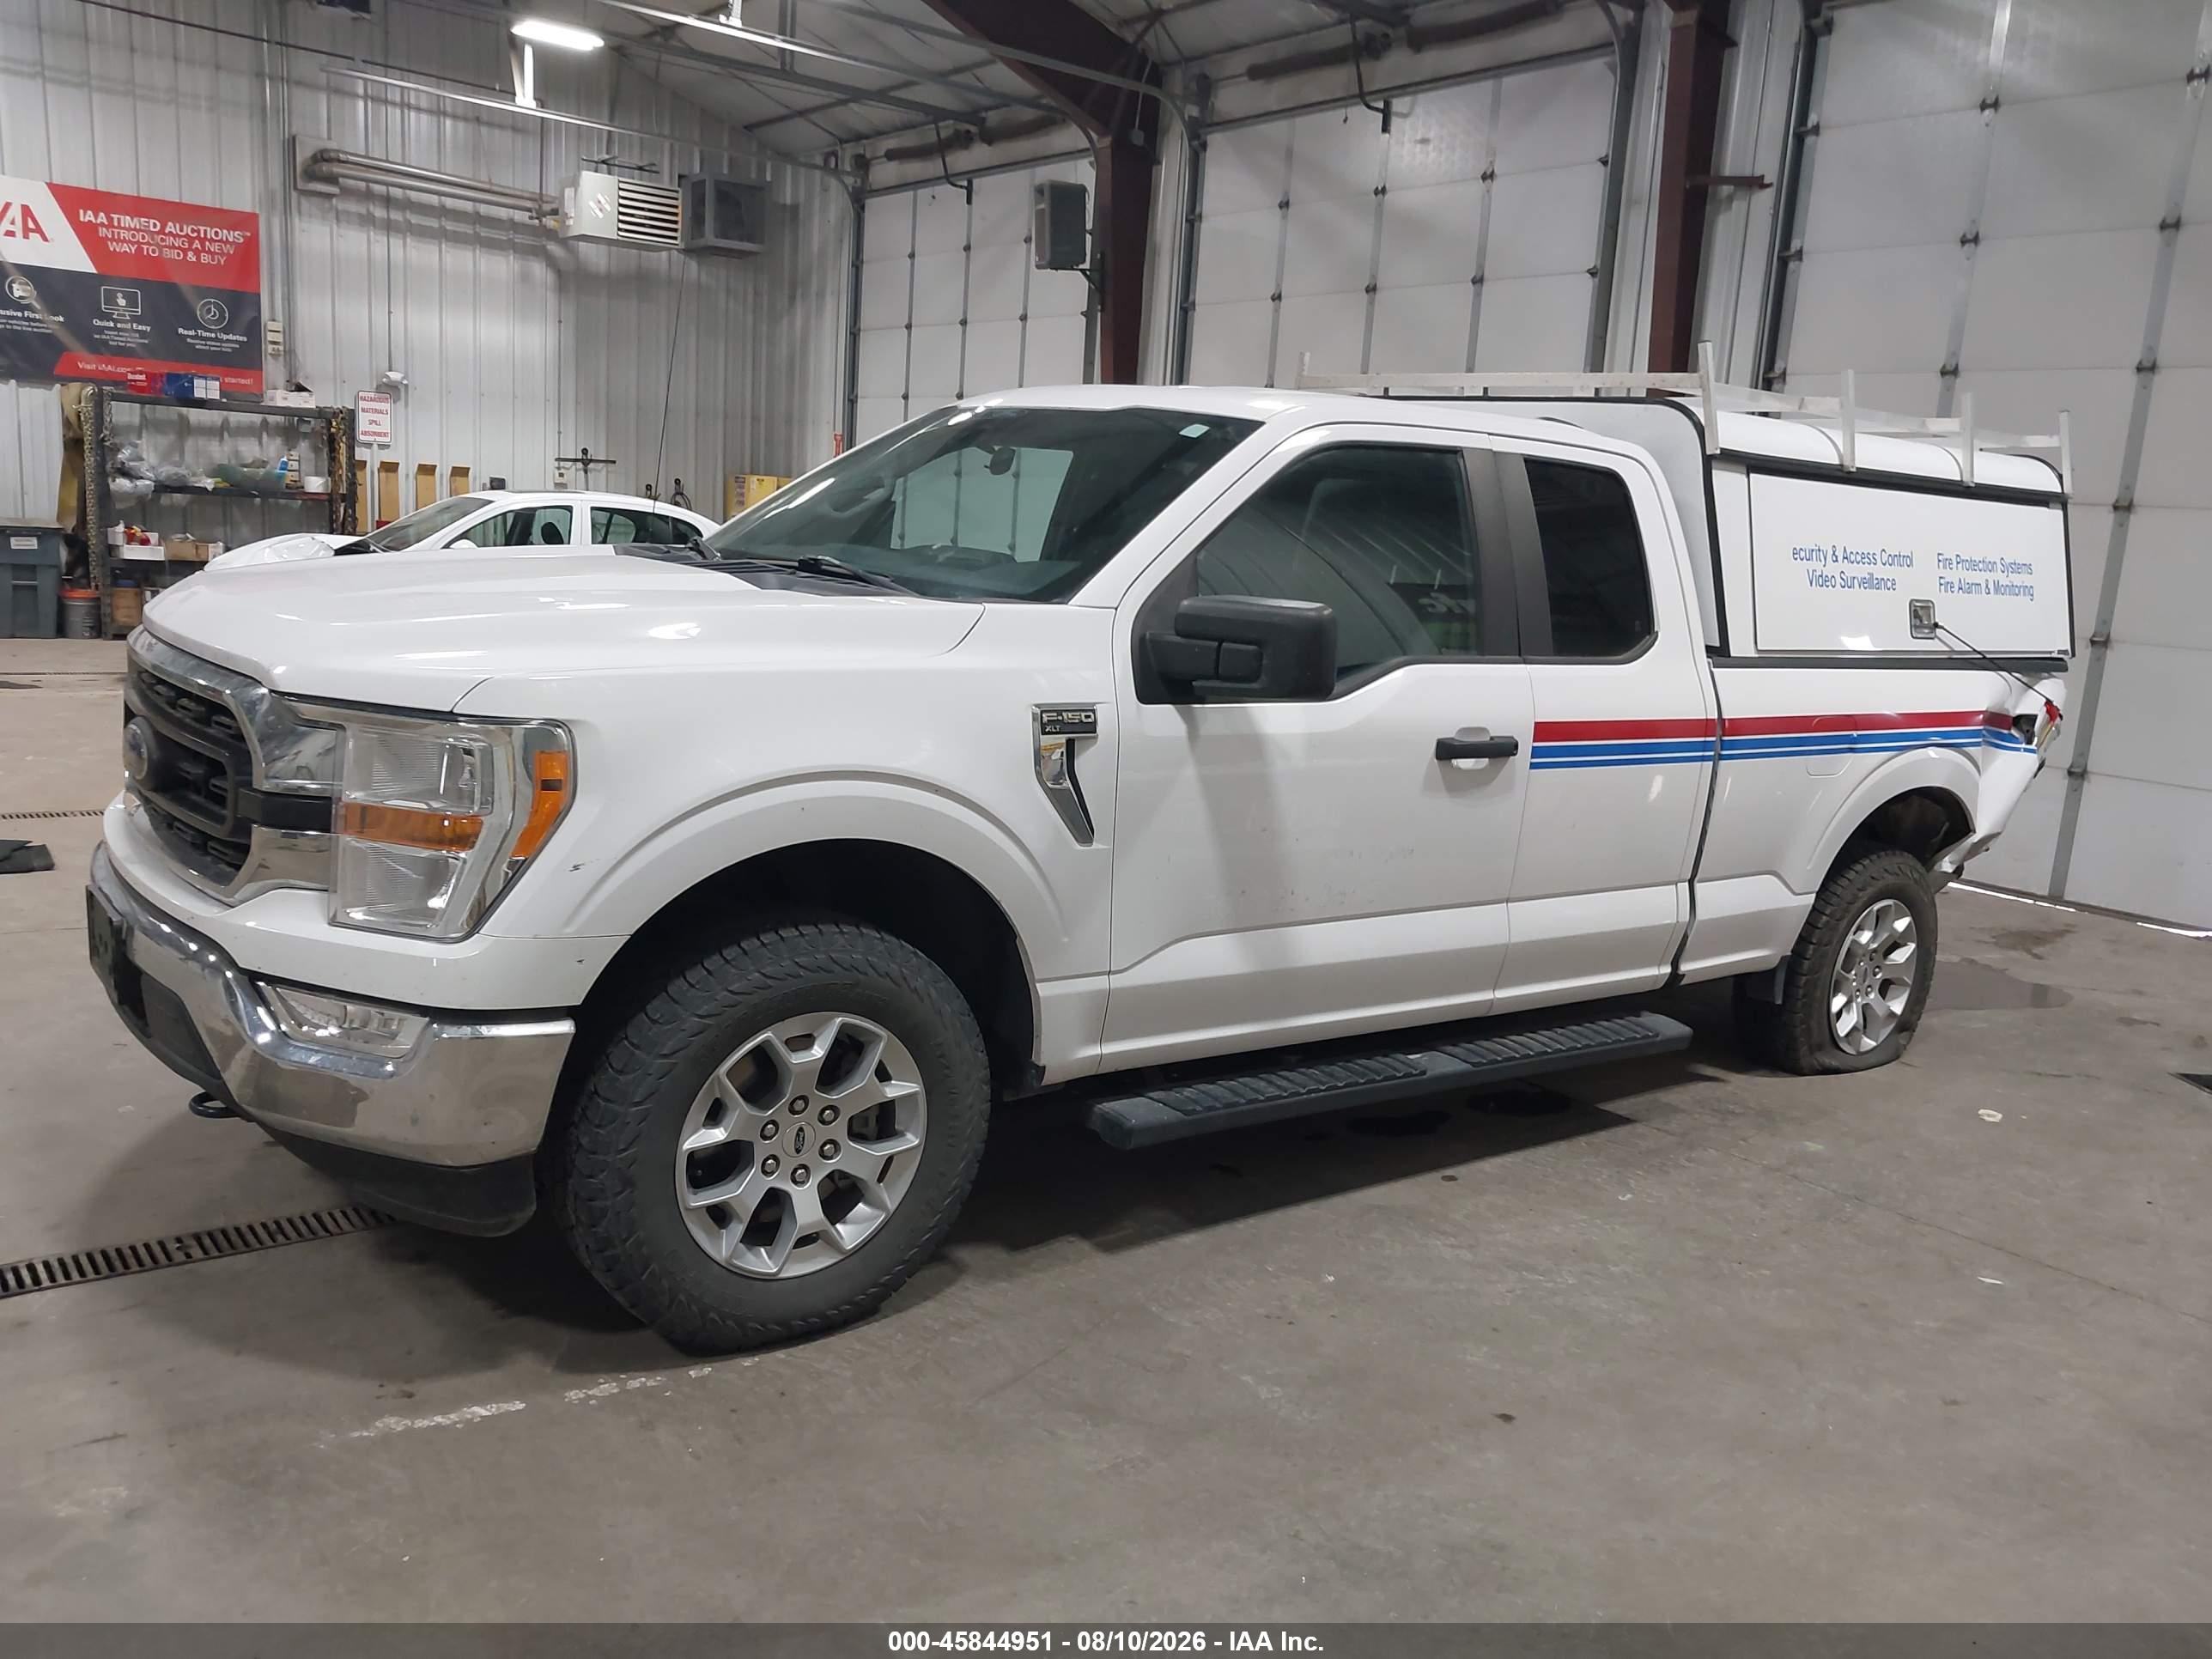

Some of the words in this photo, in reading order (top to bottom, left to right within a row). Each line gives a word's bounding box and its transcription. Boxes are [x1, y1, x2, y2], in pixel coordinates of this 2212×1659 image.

[79, 209, 108, 226] IAA
[110, 214, 161, 232] TIMED
[98, 226, 188, 248] INTRODUCING
[192, 239, 205, 251] A
[205, 242, 235, 255] NEW
[107, 240, 137, 253] WAY
[142, 245, 159, 257] TO
[162, 247, 183, 260] BID
[186, 251, 197, 262] &
[200, 252, 227, 265] BUY
[93, 319, 115, 327] Quick
[132, 323, 152, 332] Easy
[177, 327, 216, 338] Real-Time
[217, 332, 248, 343] Updates
[76, 362, 96, 371] Visit
[361, 406, 389, 416] MATERIALS
[1791, 544, 1828, 568] ecurity
[1831, 544, 1839, 564] &
[1842, 545, 1878, 566] Access
[1880, 549, 1914, 568] Control
[1936, 552, 1954, 571] Fire
[1955, 553, 1998, 574] Protection
[1999, 556, 2033, 578] Systems
[1806, 568, 1837, 588] Video
[1839, 570, 1897, 591] Surveillance
[1938, 575, 1954, 594] Fire
[1958, 577, 1983, 595] Alarm
[1984, 578, 1991, 595] &
[1992, 579, 2034, 602] Monitoring
[1042, 712, 1095, 724] F-150
